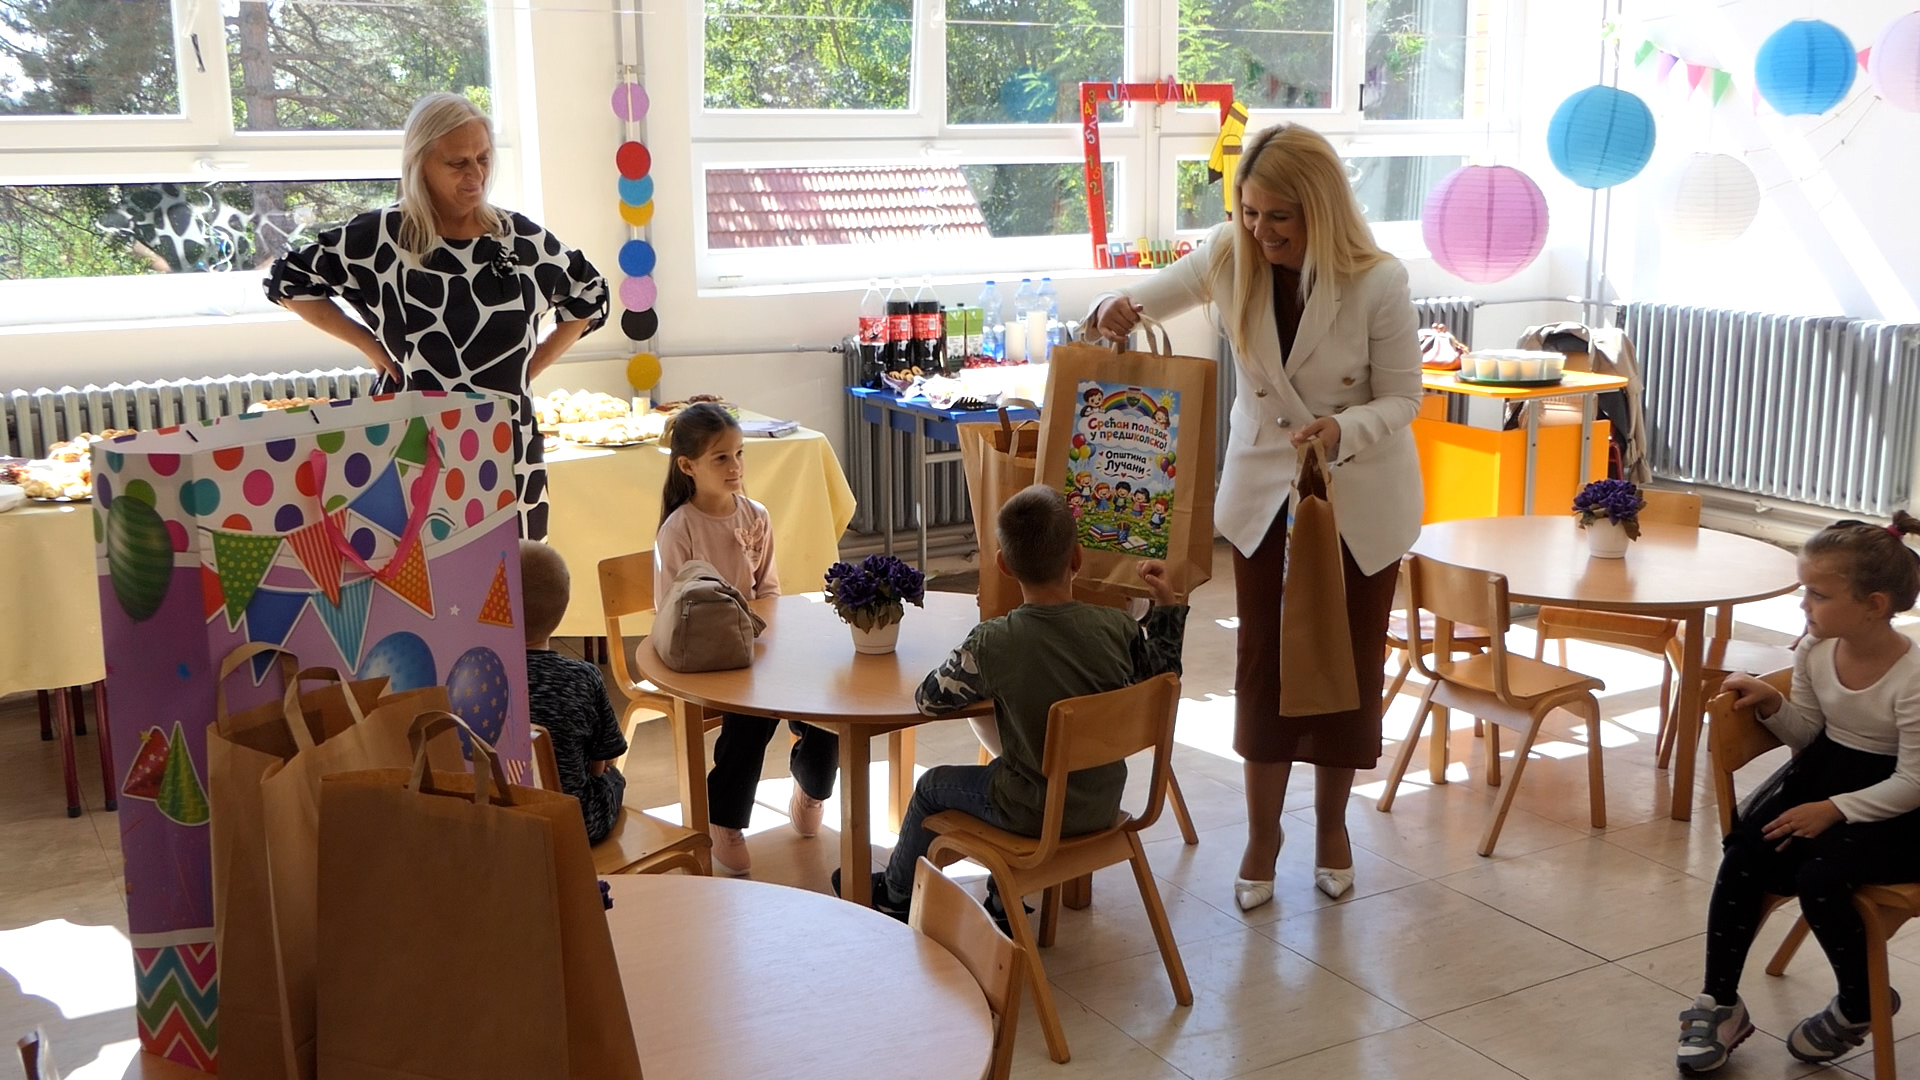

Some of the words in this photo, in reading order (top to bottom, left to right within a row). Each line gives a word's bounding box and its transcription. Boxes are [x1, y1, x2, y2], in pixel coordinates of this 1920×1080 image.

[1096, 237, 1205, 269] ПРЕДШКО
[1088, 417, 1129, 430] Срећан
[1131, 422, 1168, 441] полазак
[1090, 431, 1097, 441] у
[1100, 430, 1168, 452] предшколско!
[1104, 460, 1145, 475] Лучани
[1105, 450, 1147, 464] Општина
